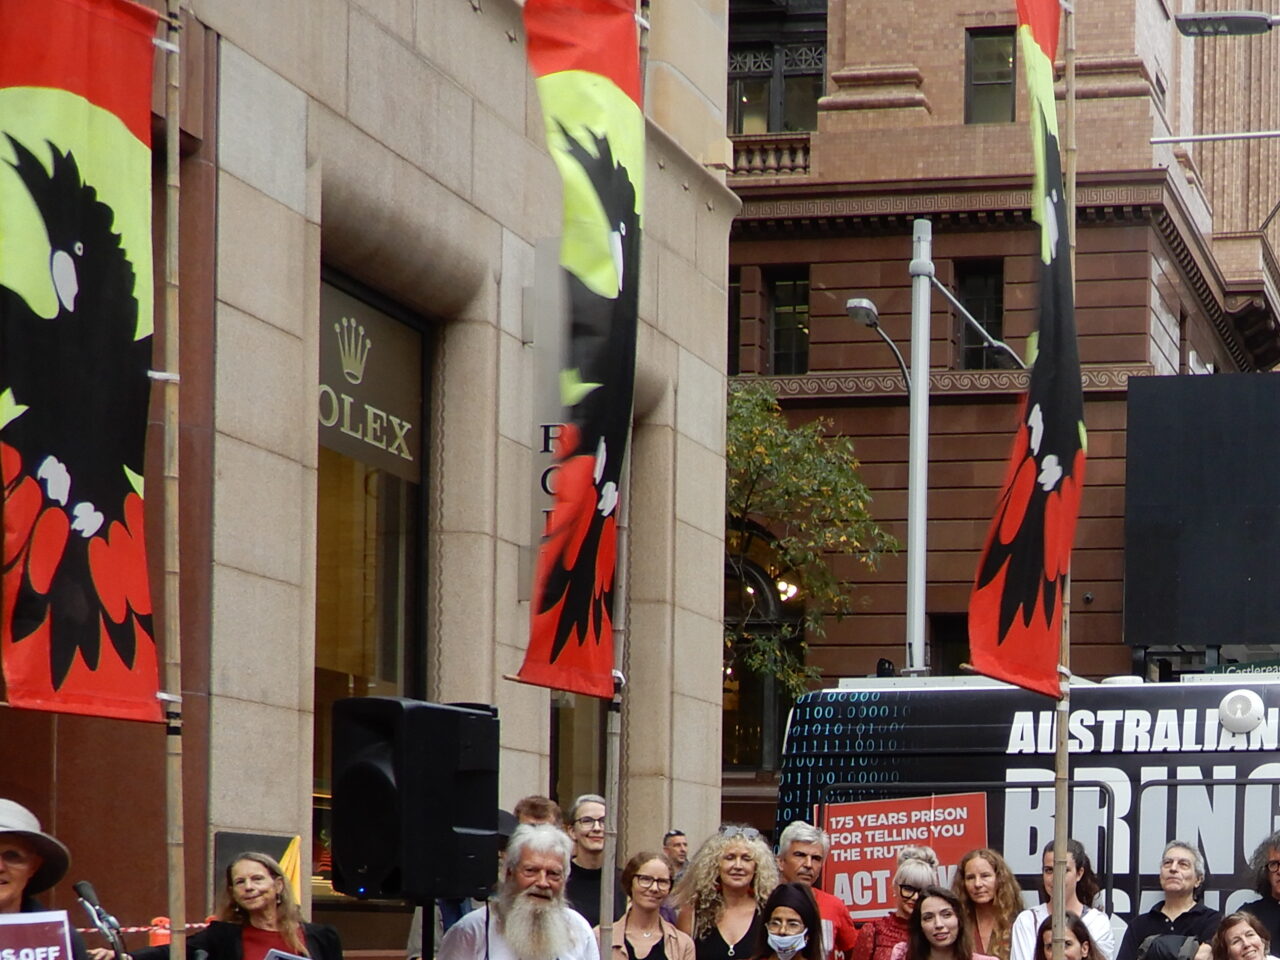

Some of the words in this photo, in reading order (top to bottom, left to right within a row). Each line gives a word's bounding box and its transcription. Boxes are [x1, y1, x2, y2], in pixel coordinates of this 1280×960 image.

[830, 816, 854, 830] 175
[857, 813, 908, 828] YEARS
[911, 807, 968, 823] PRISON
[831, 832, 862, 846] FOR
[865, 827, 929, 844] TELLING
[931, 823, 965, 838] YOU
[831, 848, 861, 862] THE
[864, 845, 914, 860] TRUT
[833, 870, 891, 906] ACT
